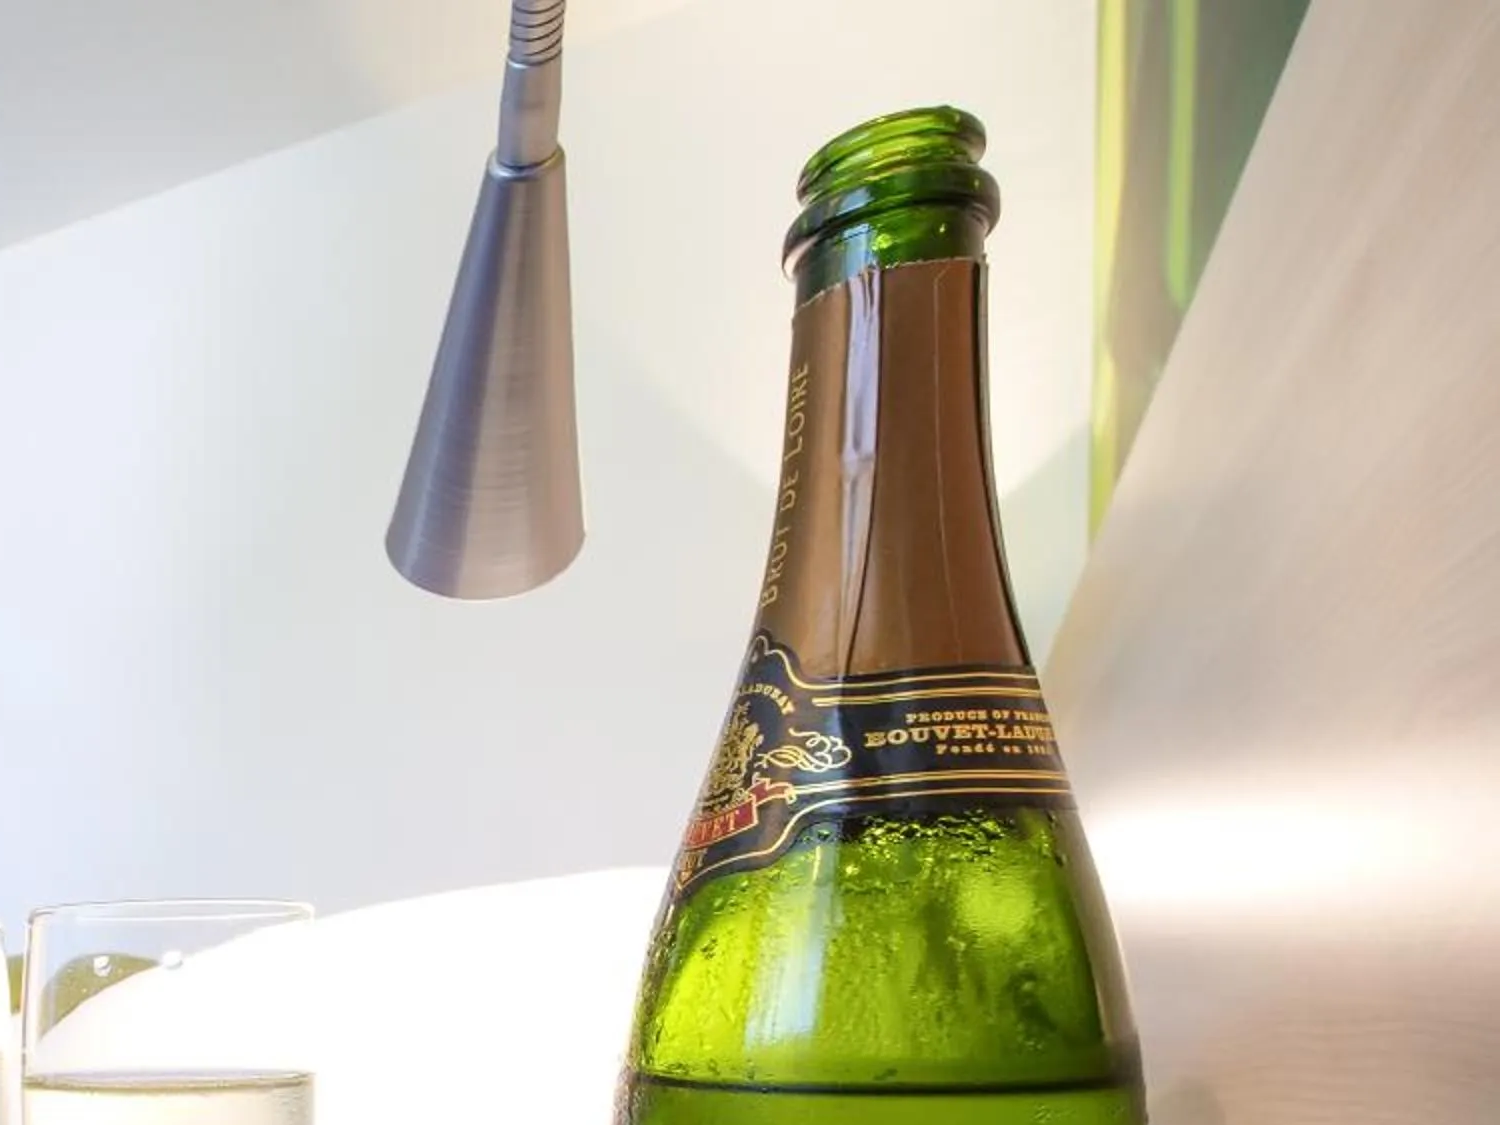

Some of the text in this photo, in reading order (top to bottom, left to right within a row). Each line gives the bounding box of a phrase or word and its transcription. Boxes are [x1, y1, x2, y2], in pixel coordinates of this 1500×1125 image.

[759, 363, 809, 607] BRUT DE LOIRE
